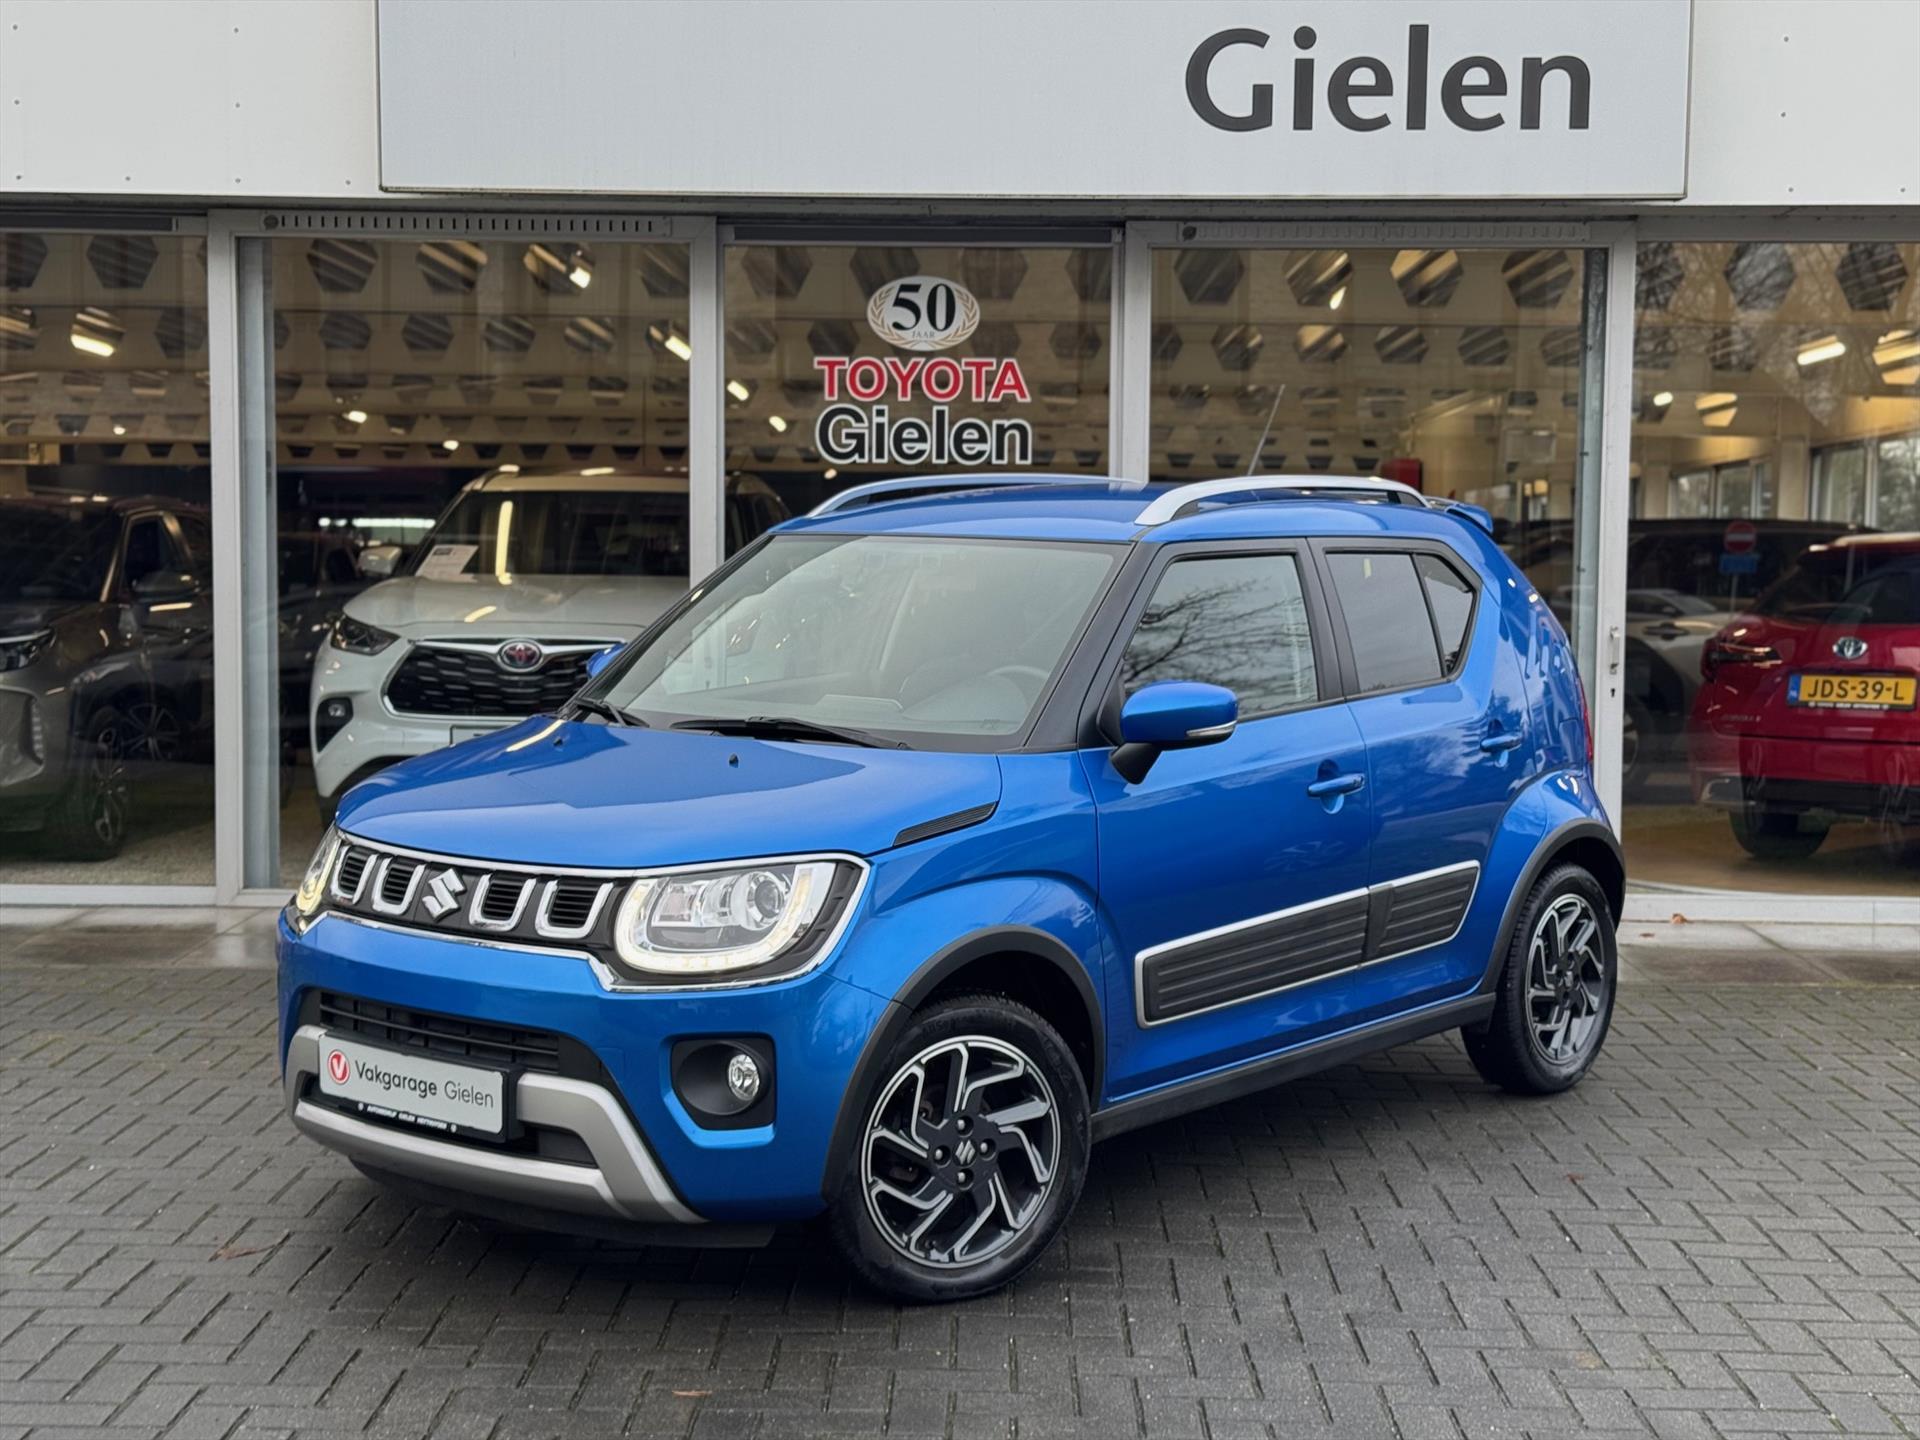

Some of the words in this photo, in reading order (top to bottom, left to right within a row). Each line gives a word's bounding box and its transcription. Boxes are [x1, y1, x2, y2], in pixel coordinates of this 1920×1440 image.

[1185, 24, 1591, 132] Gielen
[892, 283, 956, 331] 50
[814, 356, 1031, 401] TOYOTA
[816, 404, 1032, 465] Gielen
[1808, 679, 1904, 701] JDS-39-L
[355, 1060, 438, 1098] Vakgarage
[444, 1081, 494, 1108] Gielen
